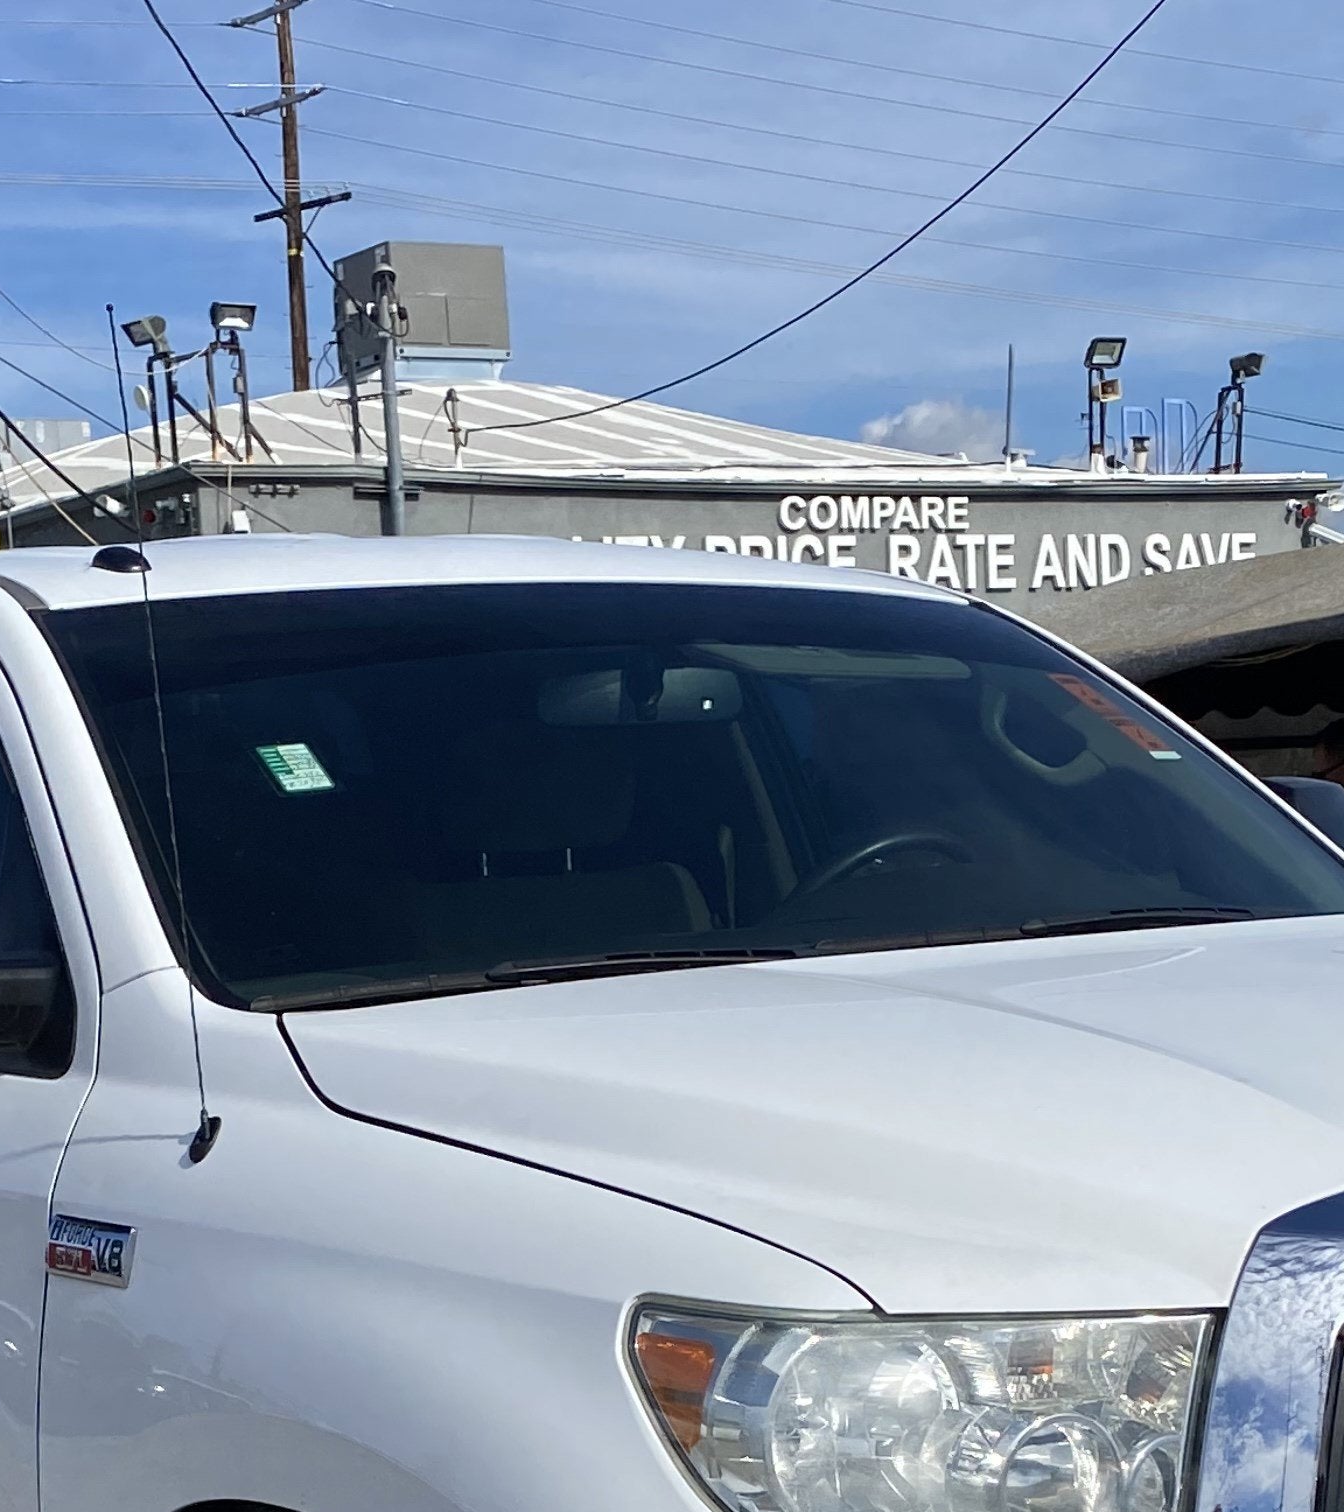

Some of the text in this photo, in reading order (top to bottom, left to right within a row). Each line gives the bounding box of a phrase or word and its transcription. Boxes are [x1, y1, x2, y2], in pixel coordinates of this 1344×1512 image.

[779, 495, 970, 531] COMPARE
[888, 533, 1018, 589] RATE
[1032, 533, 1131, 589] AND
